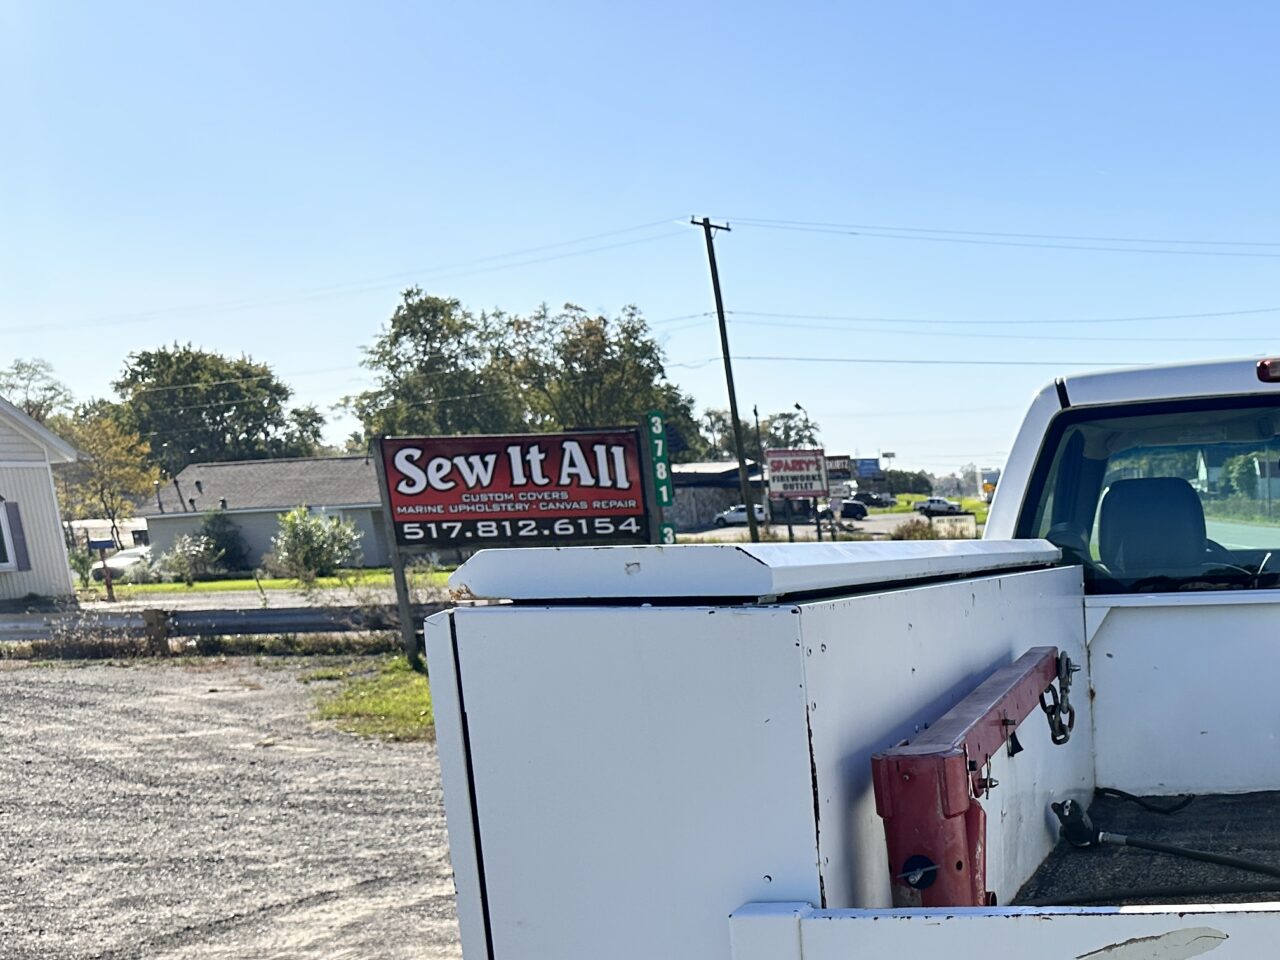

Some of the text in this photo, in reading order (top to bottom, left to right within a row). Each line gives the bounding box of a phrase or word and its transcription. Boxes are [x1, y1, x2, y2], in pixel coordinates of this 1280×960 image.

[394, 441, 631, 494] Sew It All
[651, 416, 669, 502] 3781
[782, 482, 814, 491] OUTLET
[462, 491, 569, 502] CUSTOM COVERS
[396, 499, 637, 514] MARINE UPHOLSTERY CANVAS REPAIR
[403, 517, 641, 540] 517.812.6154
